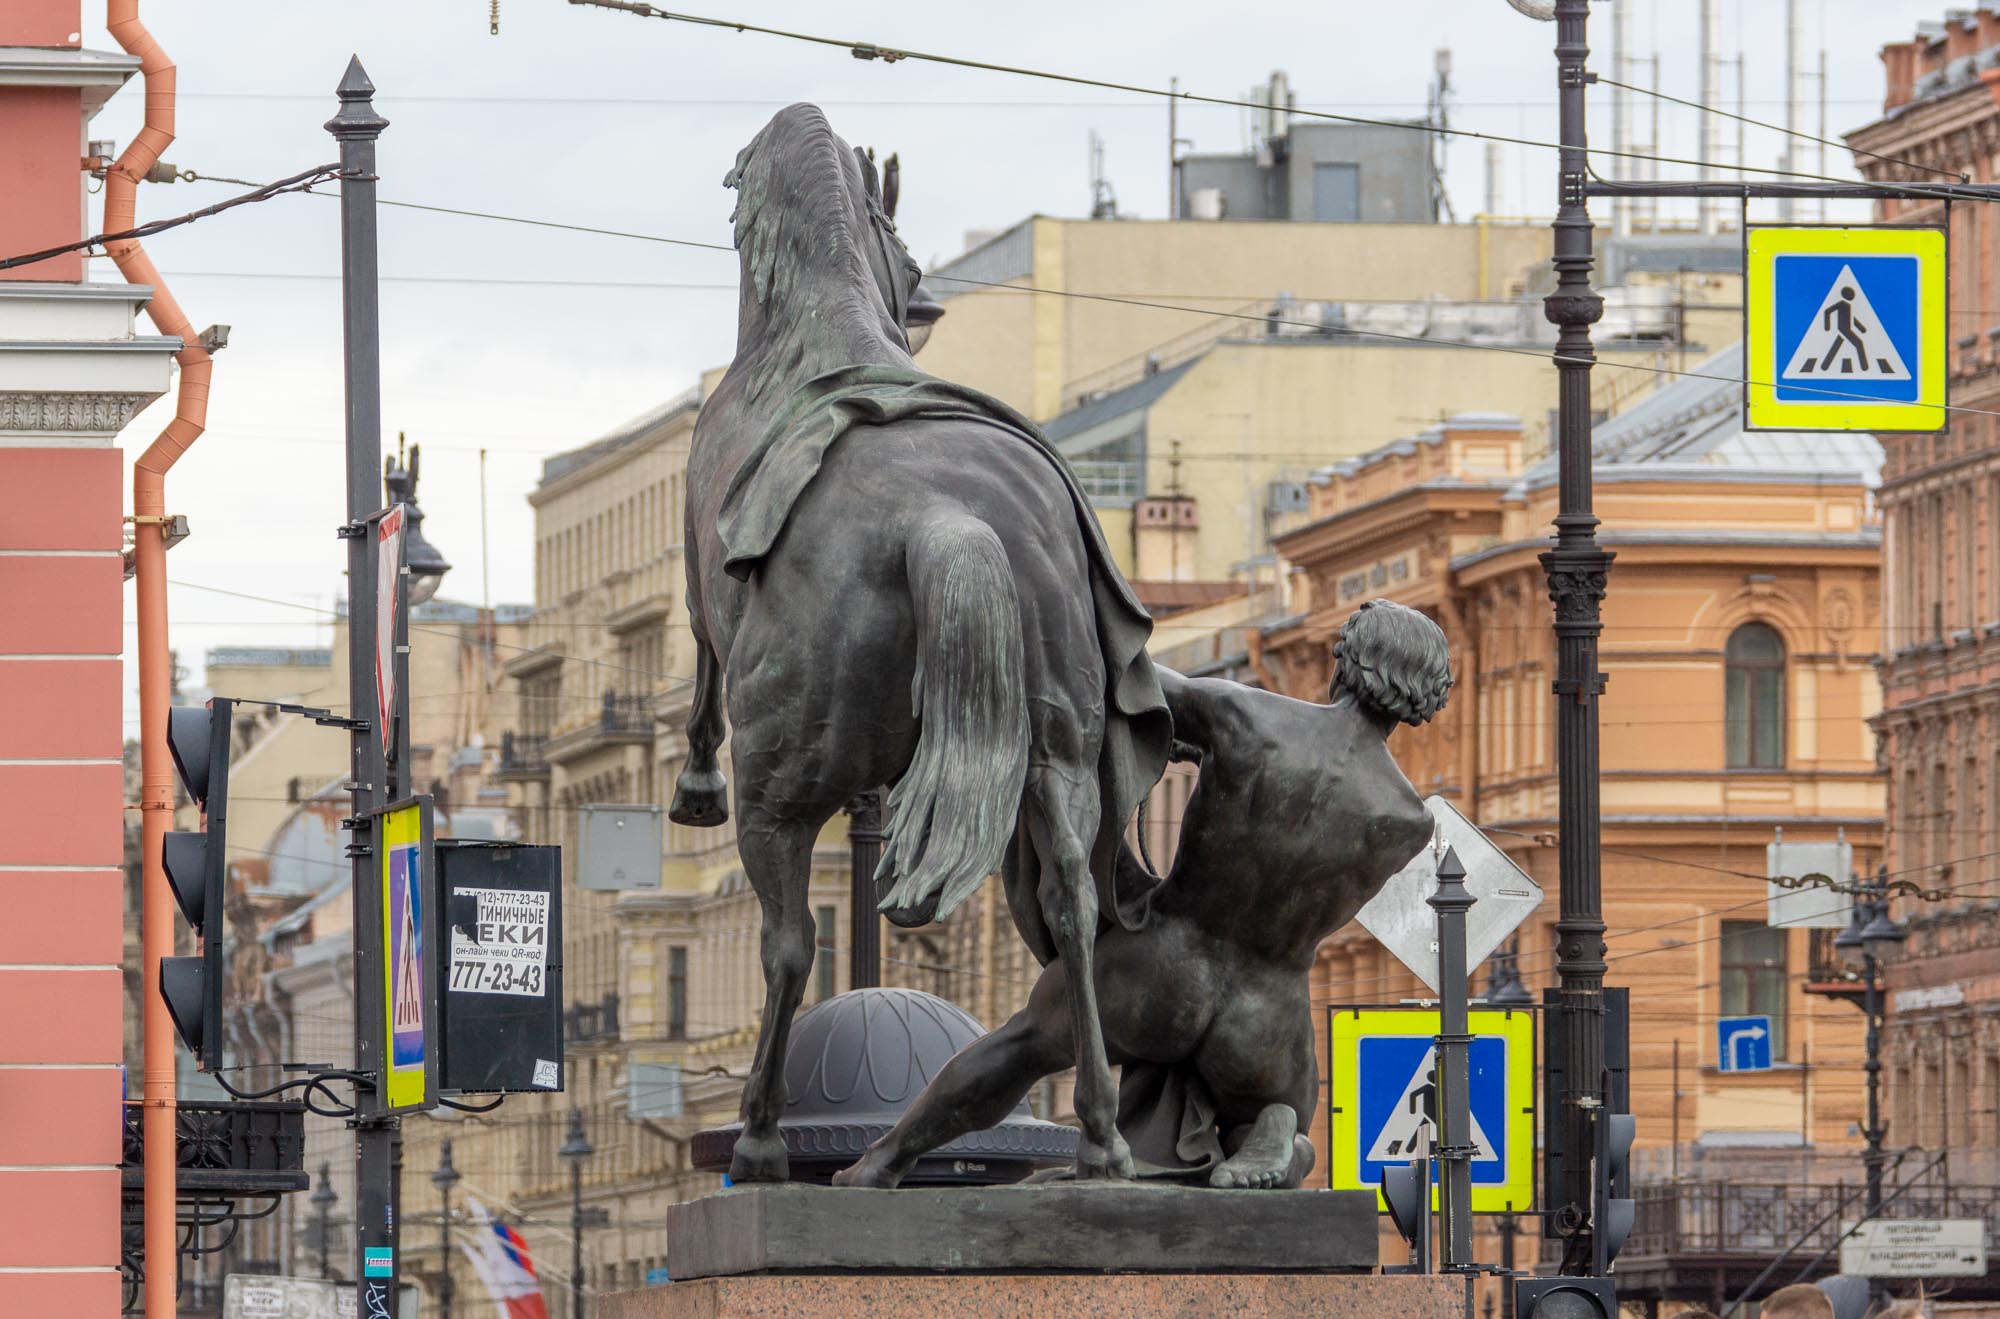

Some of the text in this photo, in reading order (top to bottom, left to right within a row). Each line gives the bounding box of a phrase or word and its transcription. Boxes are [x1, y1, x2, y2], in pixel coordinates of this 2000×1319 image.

[455, 946, 489, 958] он-лайн
[490, 949, 509, 958] чеки
[453, 961, 541, 993] 777-23-43
